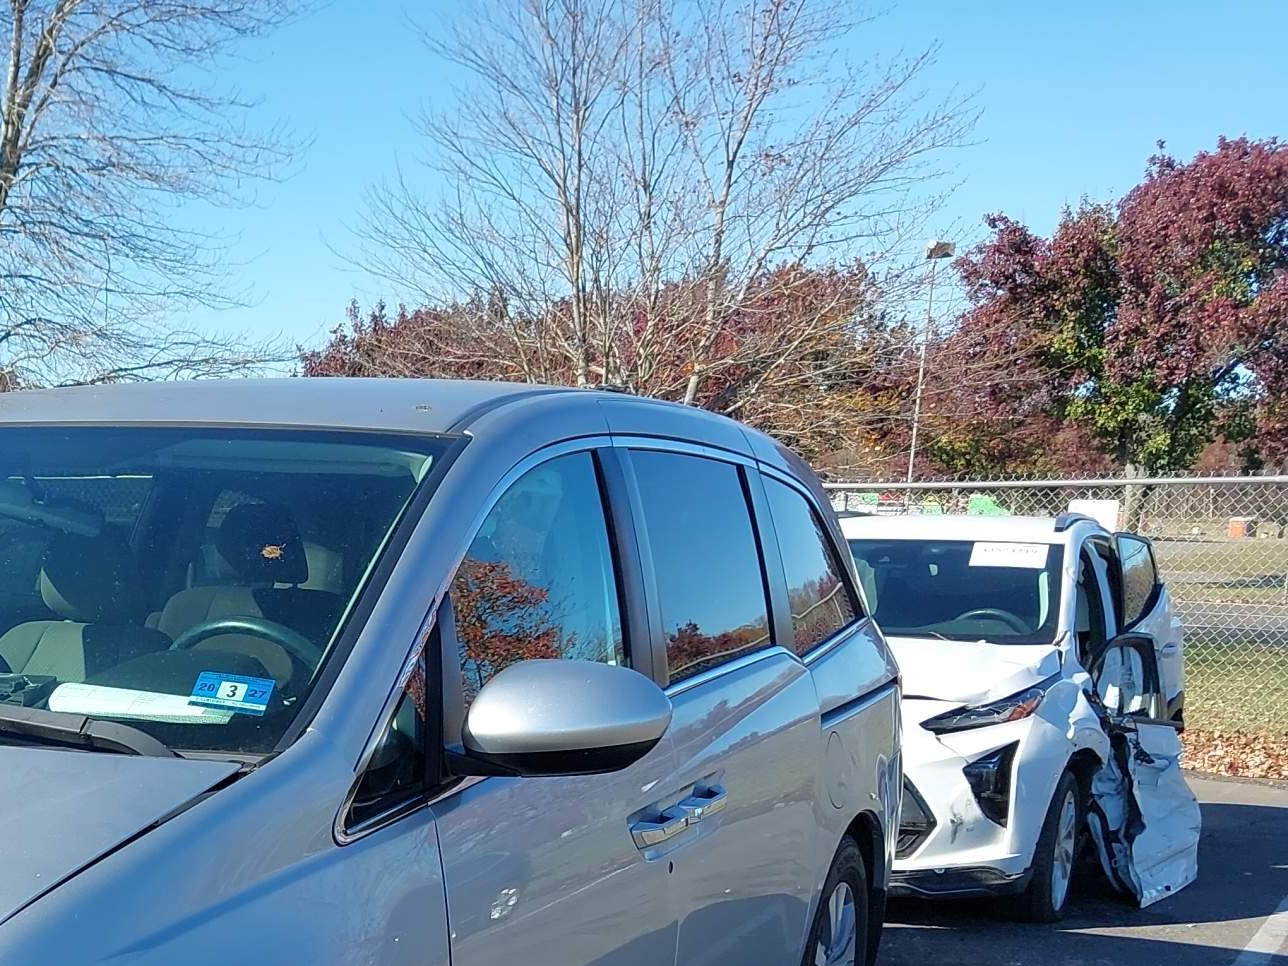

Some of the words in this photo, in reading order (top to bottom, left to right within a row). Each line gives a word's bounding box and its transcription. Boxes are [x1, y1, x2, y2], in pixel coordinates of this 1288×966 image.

[198, 682, 216, 693] 20
[225, 684, 238, 698] 3
[247, 689, 268, 699] 27
